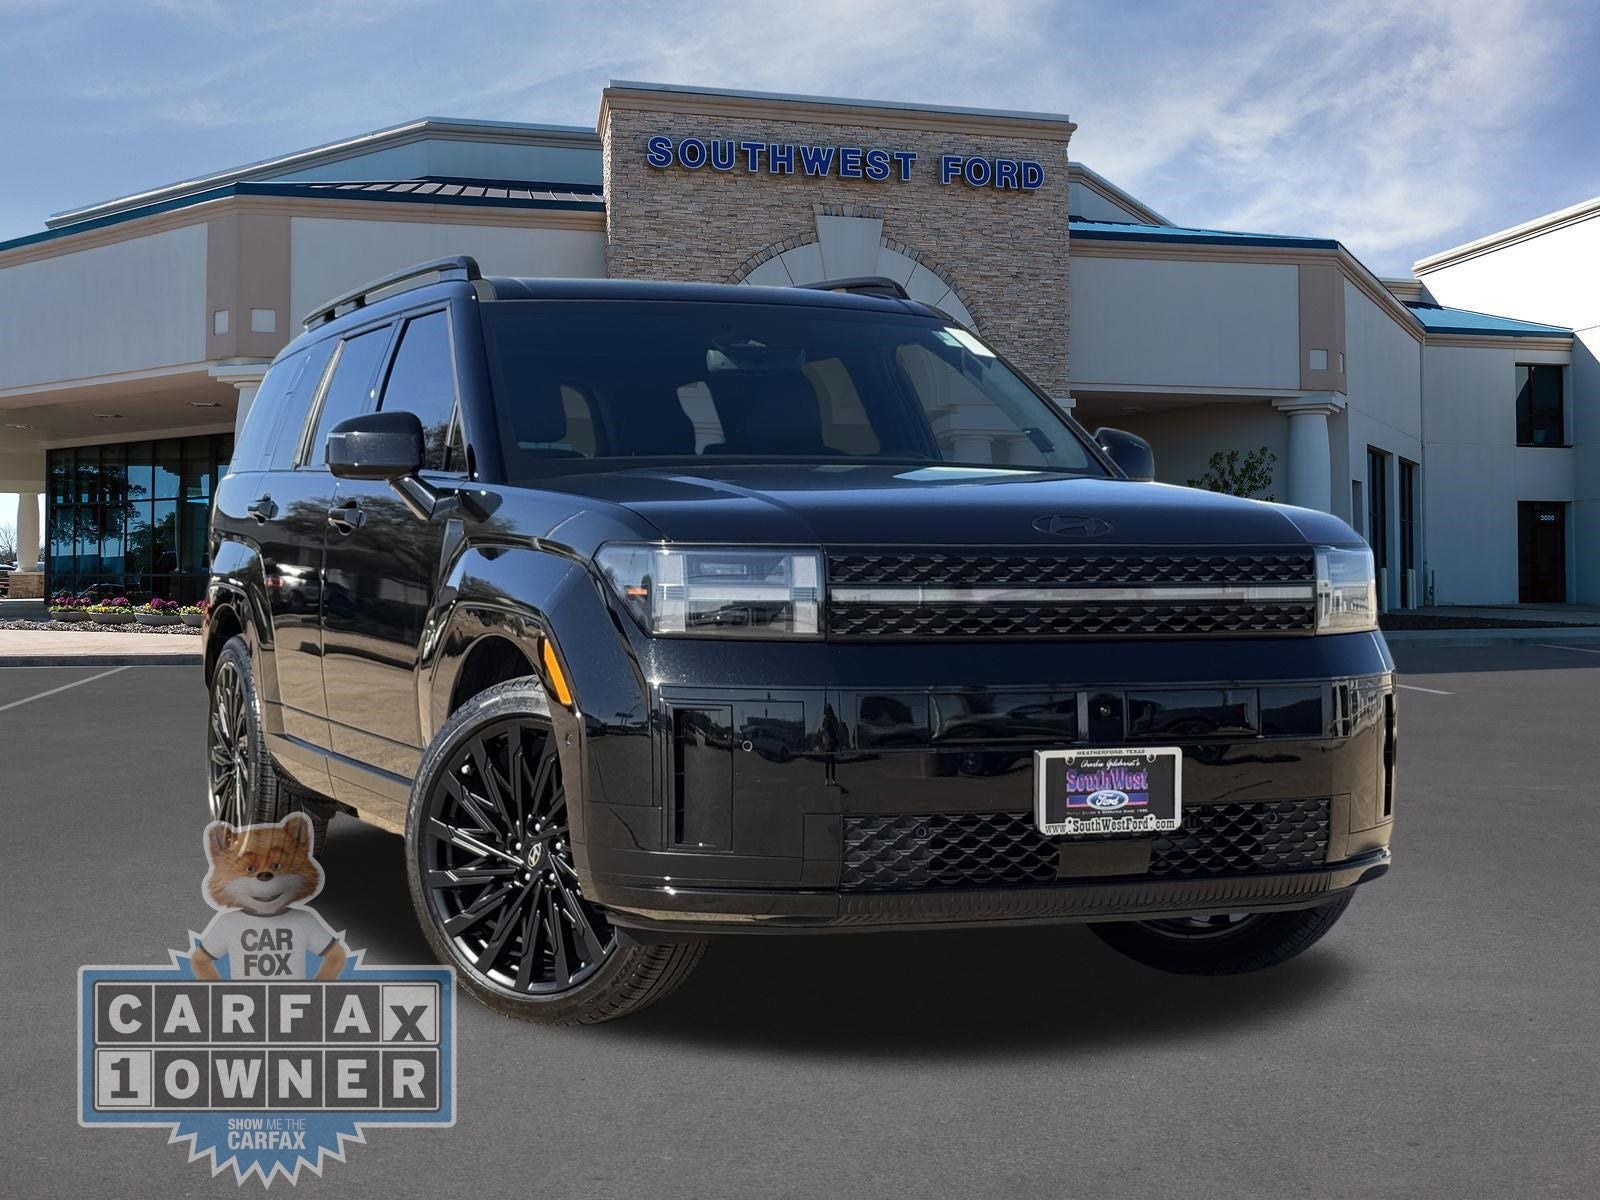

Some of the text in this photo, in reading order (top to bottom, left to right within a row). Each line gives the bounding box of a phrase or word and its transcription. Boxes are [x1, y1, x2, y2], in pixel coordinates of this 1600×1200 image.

[646, 135, 1045, 190] SOUTHWEST FORD
[1066, 767, 1149, 792] SouthWest
[1095, 792, 1119, 806] Ford
[1045, 817, 1175, 834] www.SouthWestFord.com
